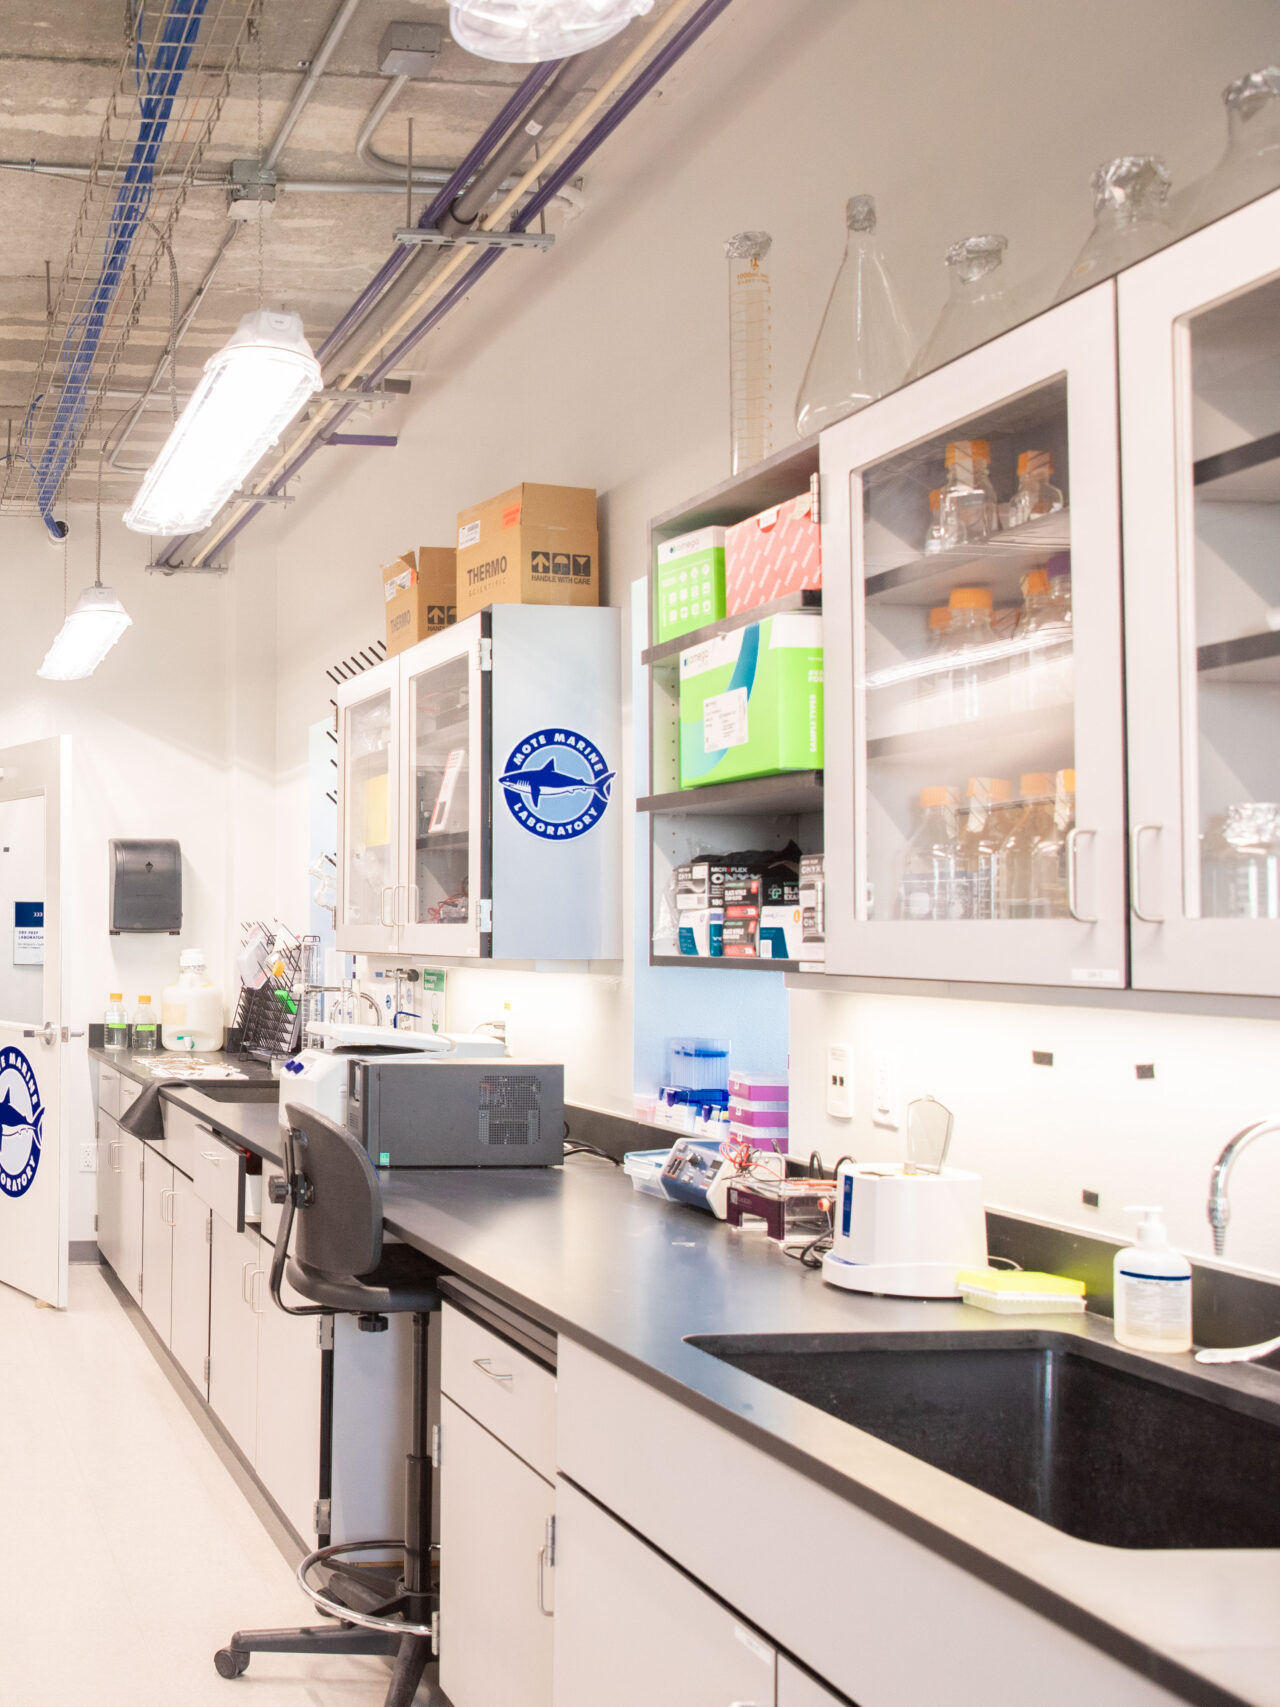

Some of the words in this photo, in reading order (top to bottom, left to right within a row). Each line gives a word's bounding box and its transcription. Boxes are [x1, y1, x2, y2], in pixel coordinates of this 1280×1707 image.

[467, 555, 508, 586] THERMO
[531, 574, 557, 583] HANDLE
[557, 575, 573, 584] WITH
[574, 577, 591, 585] CARE
[469, 579, 507, 598] SCIENTIFIC
[390, 609, 411, 633] THERMO
[513, 735, 547, 766] MOTE
[554, 733, 604, 772] MARINE
[513, 802, 598, 836] LABORATORY
[783, 886, 800, 894] BLA
[8, 1052, 39, 1105] MARINE
